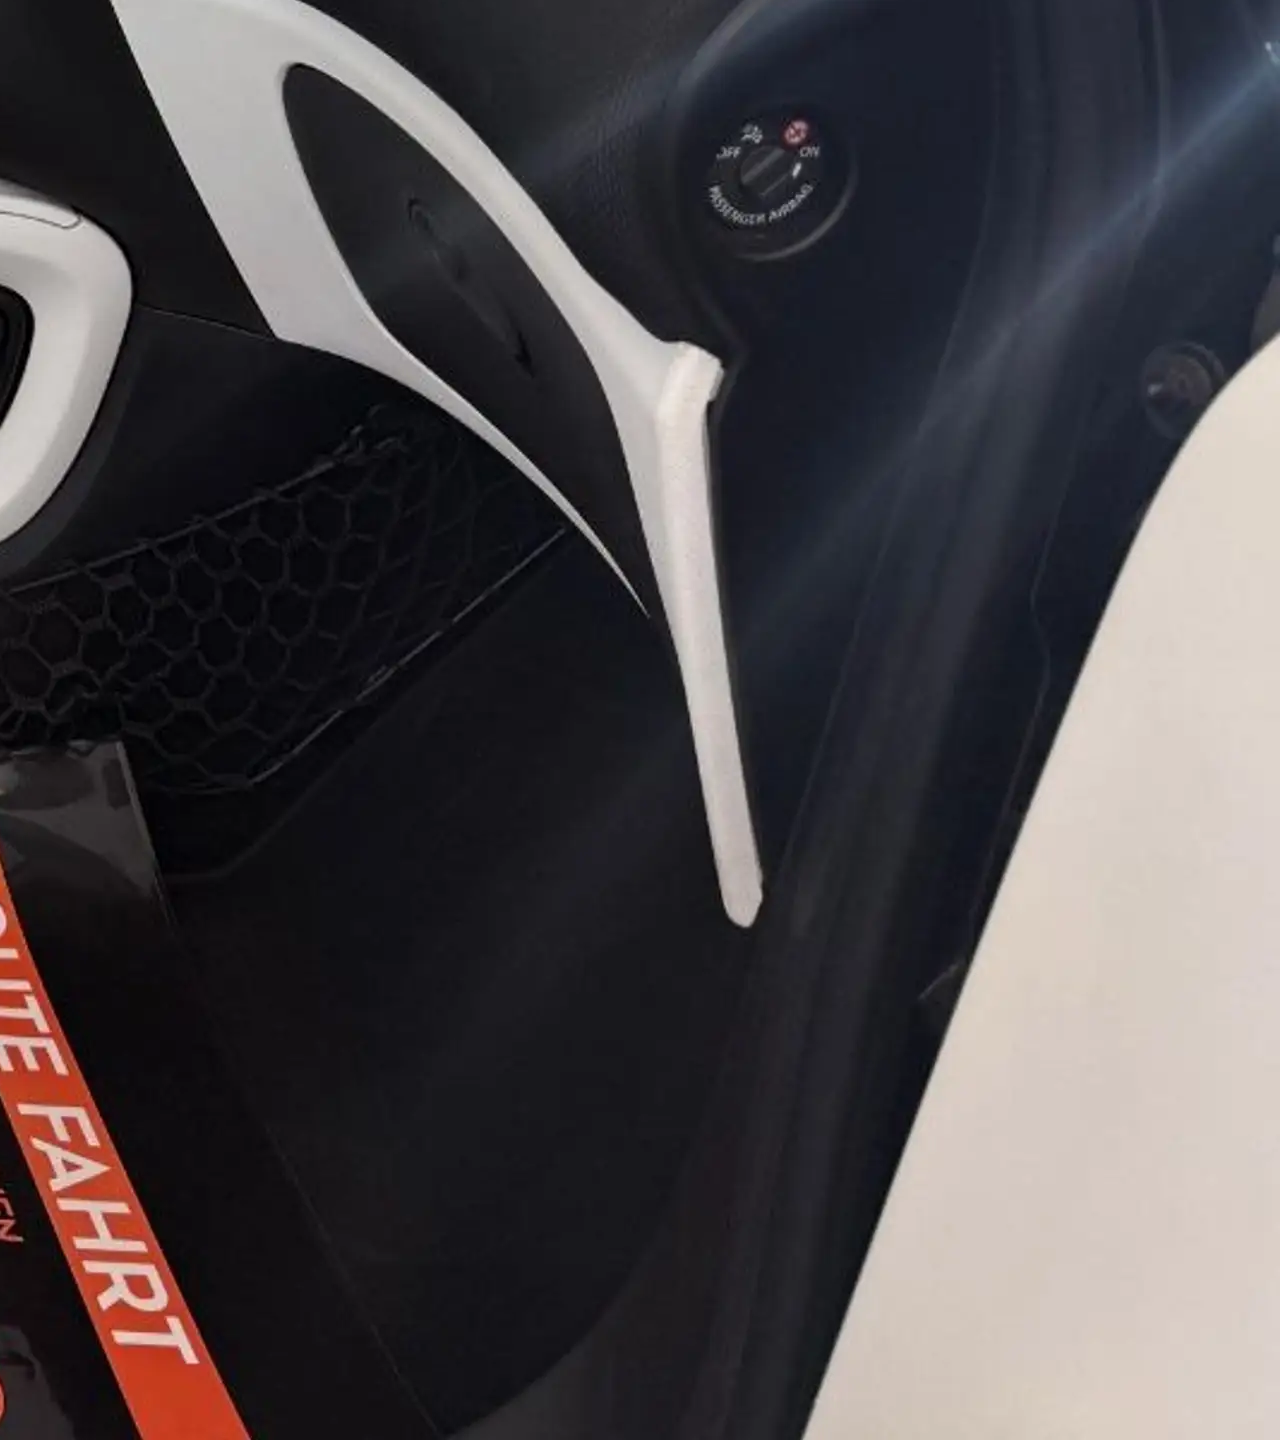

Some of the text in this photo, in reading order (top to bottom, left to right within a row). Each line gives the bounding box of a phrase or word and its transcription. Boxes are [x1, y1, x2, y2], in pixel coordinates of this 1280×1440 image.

[799, 146, 821, 158] ON
[708, 183, 814, 226] PASSENGER AIRBAG
[17, 1103, 200, 1364] FAHRT
